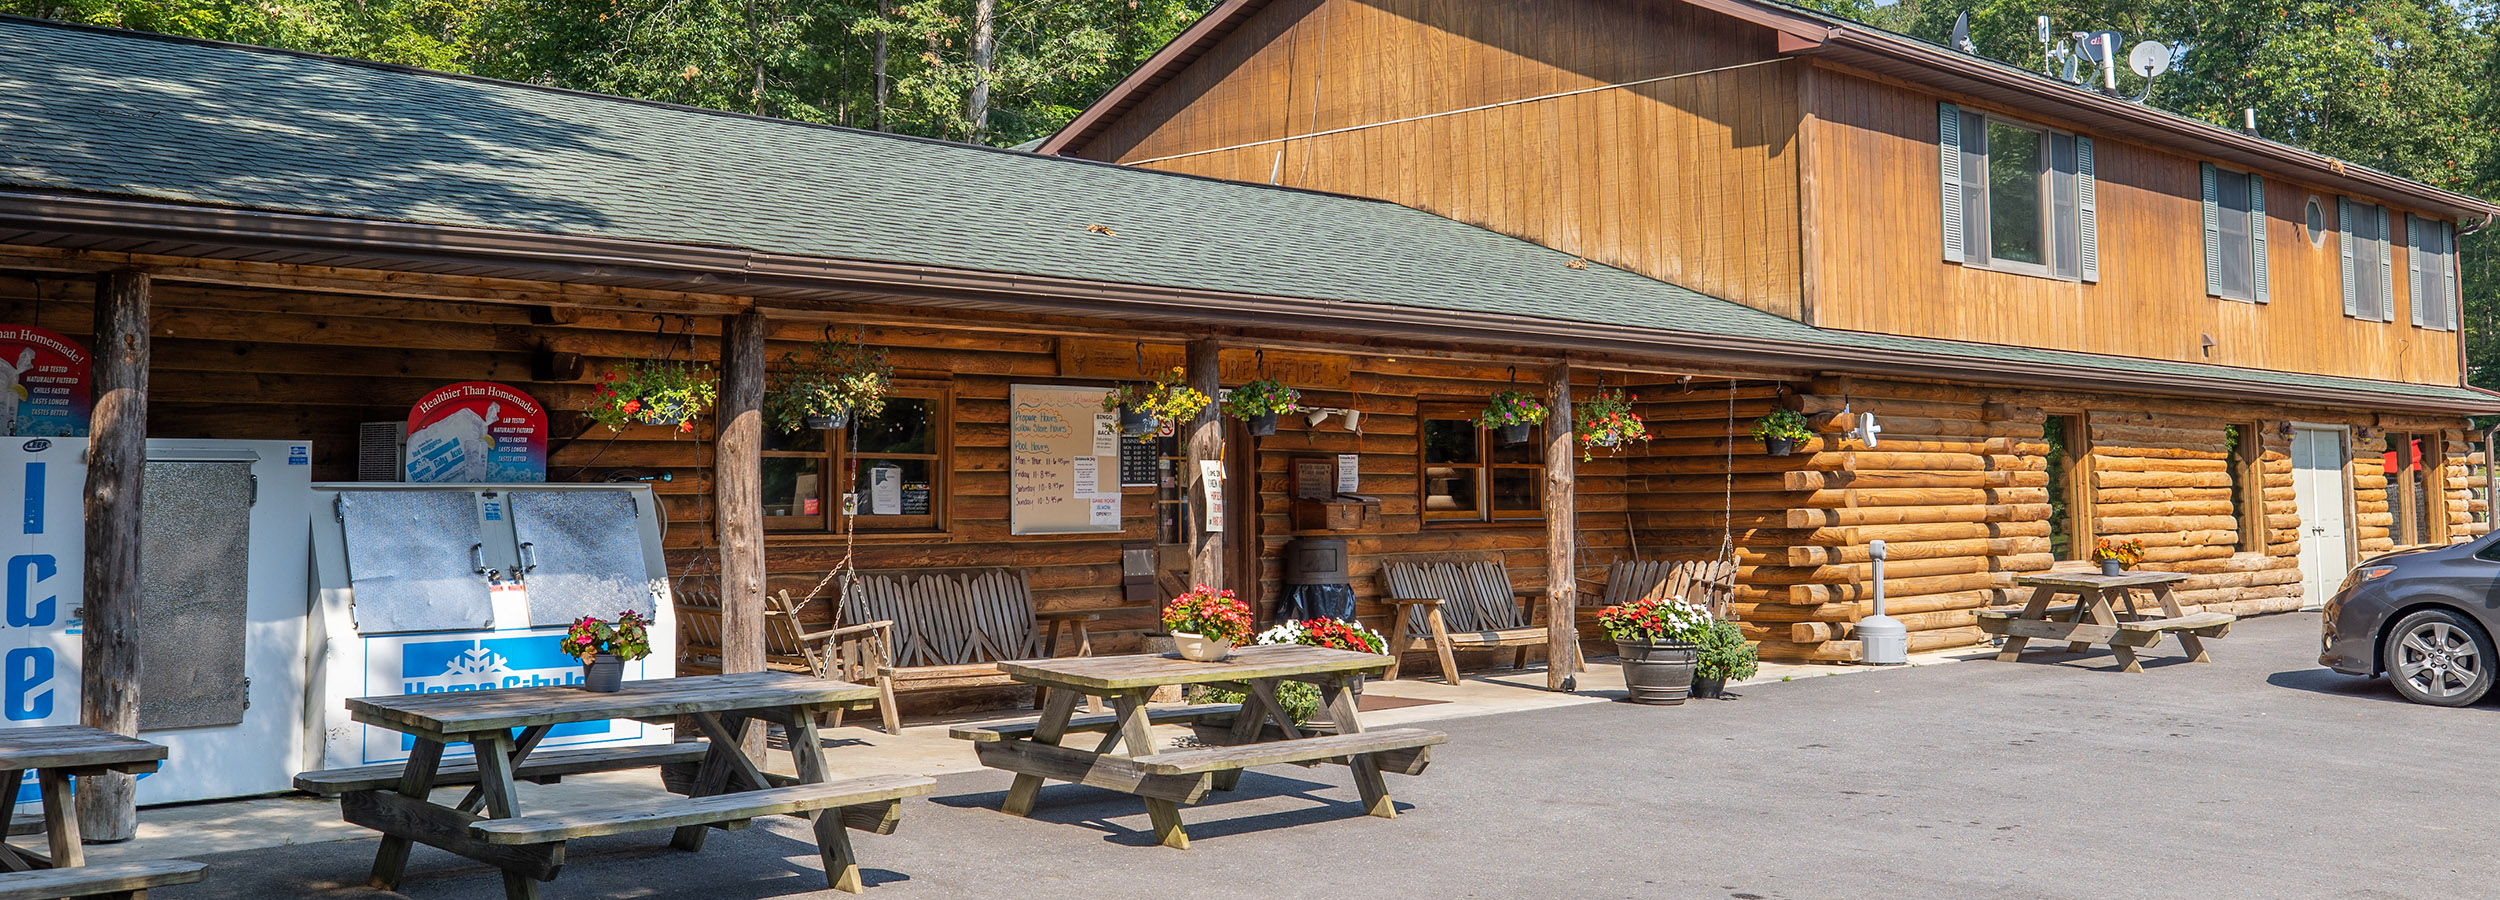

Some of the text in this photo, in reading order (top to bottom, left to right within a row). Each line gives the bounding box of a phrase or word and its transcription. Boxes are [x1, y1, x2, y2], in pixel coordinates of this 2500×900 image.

[20, 329, 85, 365] Homemade!
[1218, 358, 1253, 380] ORE
[1261, 361, 1322, 384] OFFICE
[419, 386, 538, 416] Healthier Than Homemade!
